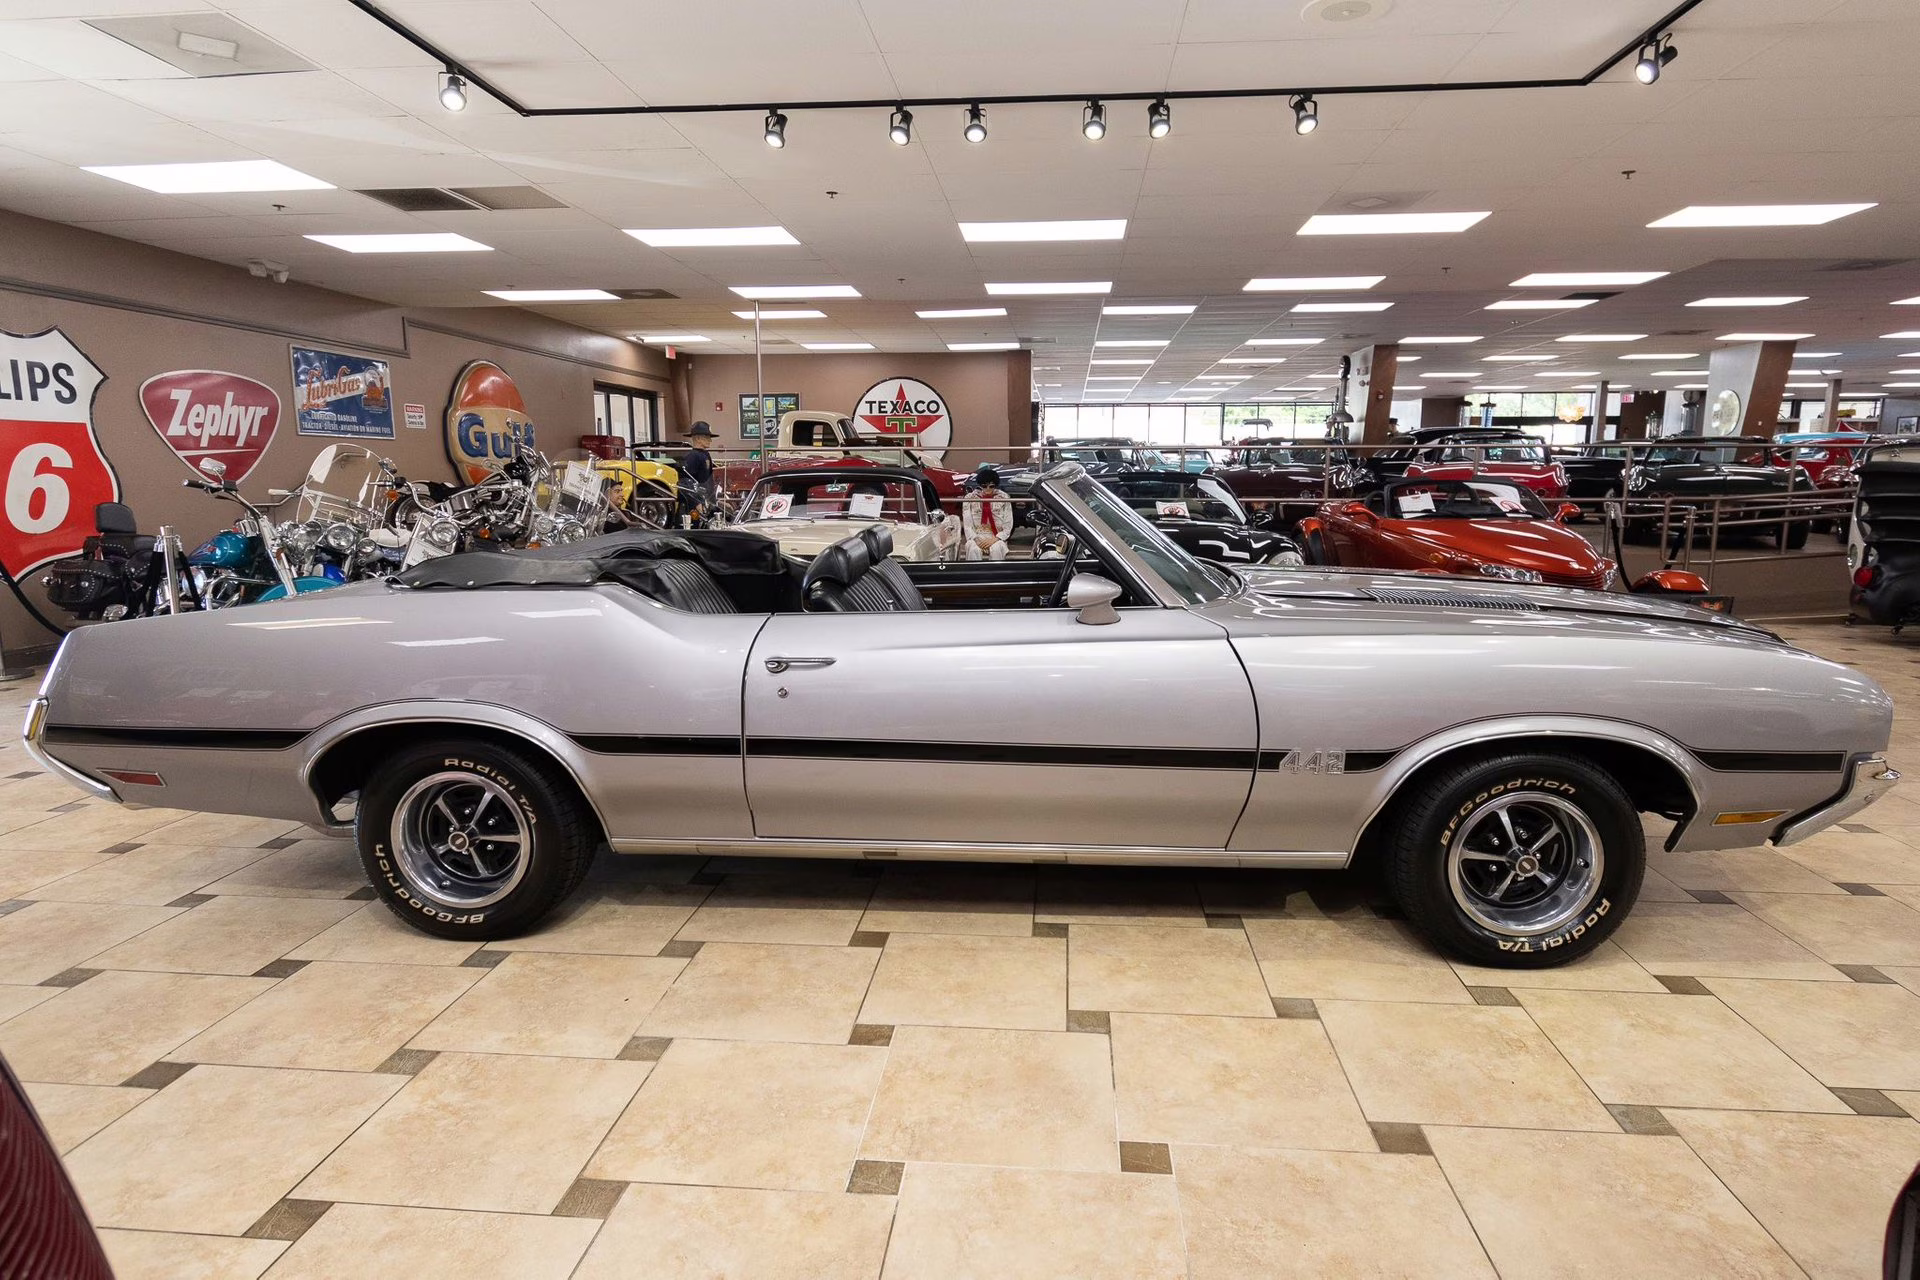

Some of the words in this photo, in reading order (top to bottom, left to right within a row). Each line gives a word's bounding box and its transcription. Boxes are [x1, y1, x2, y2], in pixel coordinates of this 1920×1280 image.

[166, 388, 269, 447] Zephyr
[865, 400, 940, 414] TEXACO
[444, 758, 517, 791] Radial
[1283, 750, 1344, 775] 442
[1440, 777, 1577, 847] BFGoodrich
[375, 844, 485, 924] BFGoodrich
[1542, 898, 1612, 951] Radial
